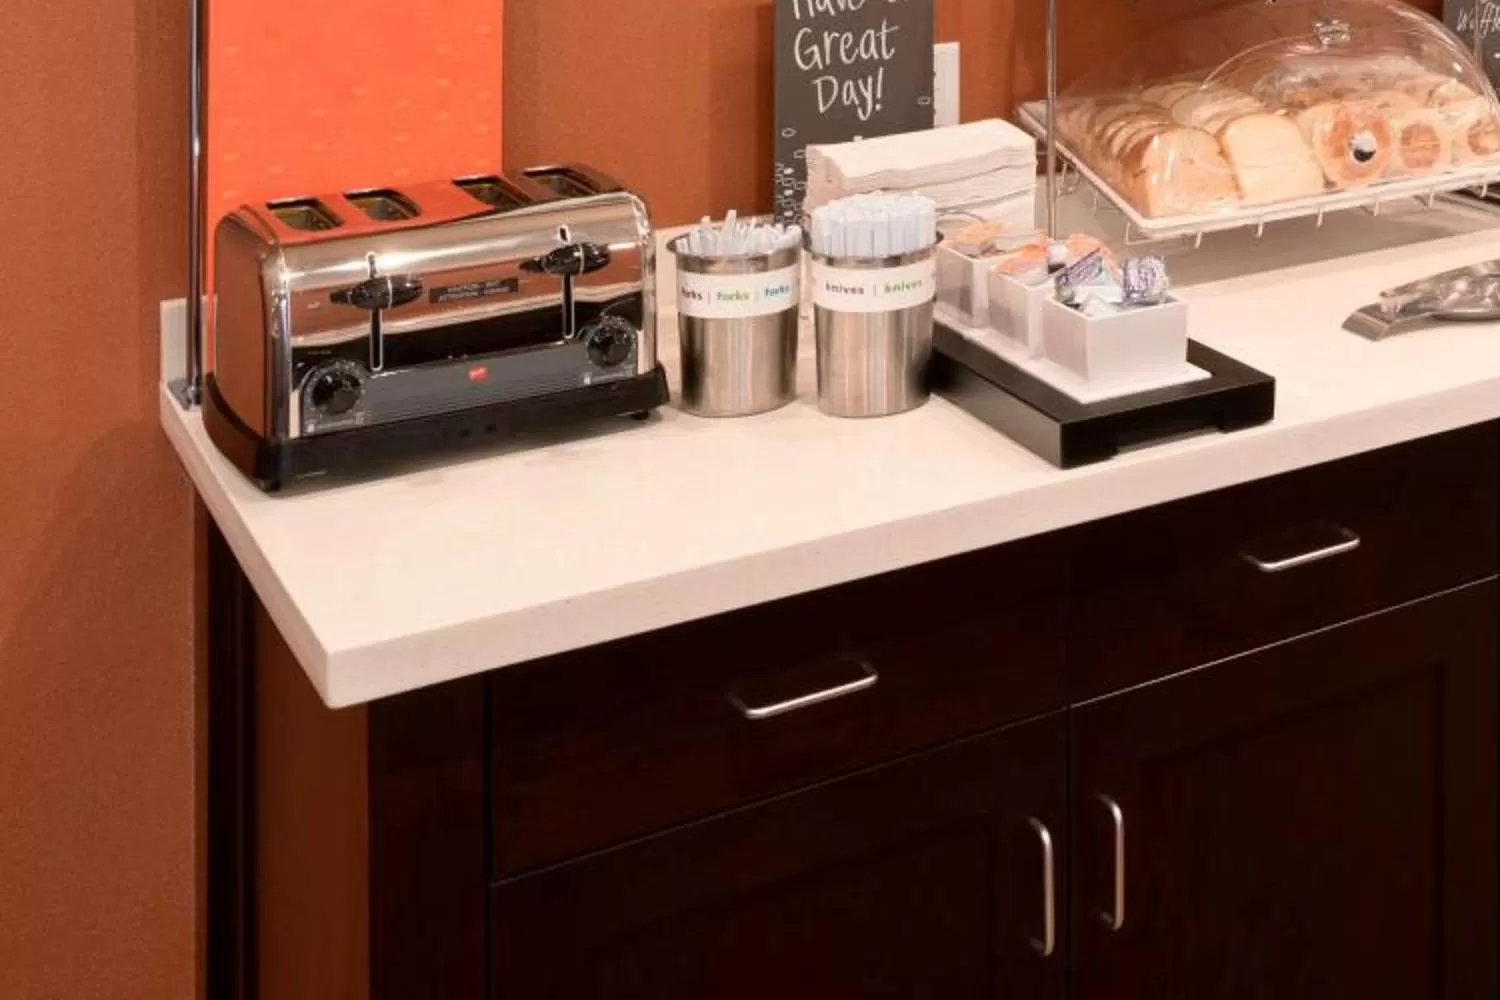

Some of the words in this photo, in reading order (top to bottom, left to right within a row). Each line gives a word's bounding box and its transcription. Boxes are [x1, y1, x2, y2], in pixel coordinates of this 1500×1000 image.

[793, 19, 899, 70] Great
[812, 67, 884, 121] Day!
[764, 284, 791, 297] forks
[825, 280, 865, 295] knives
